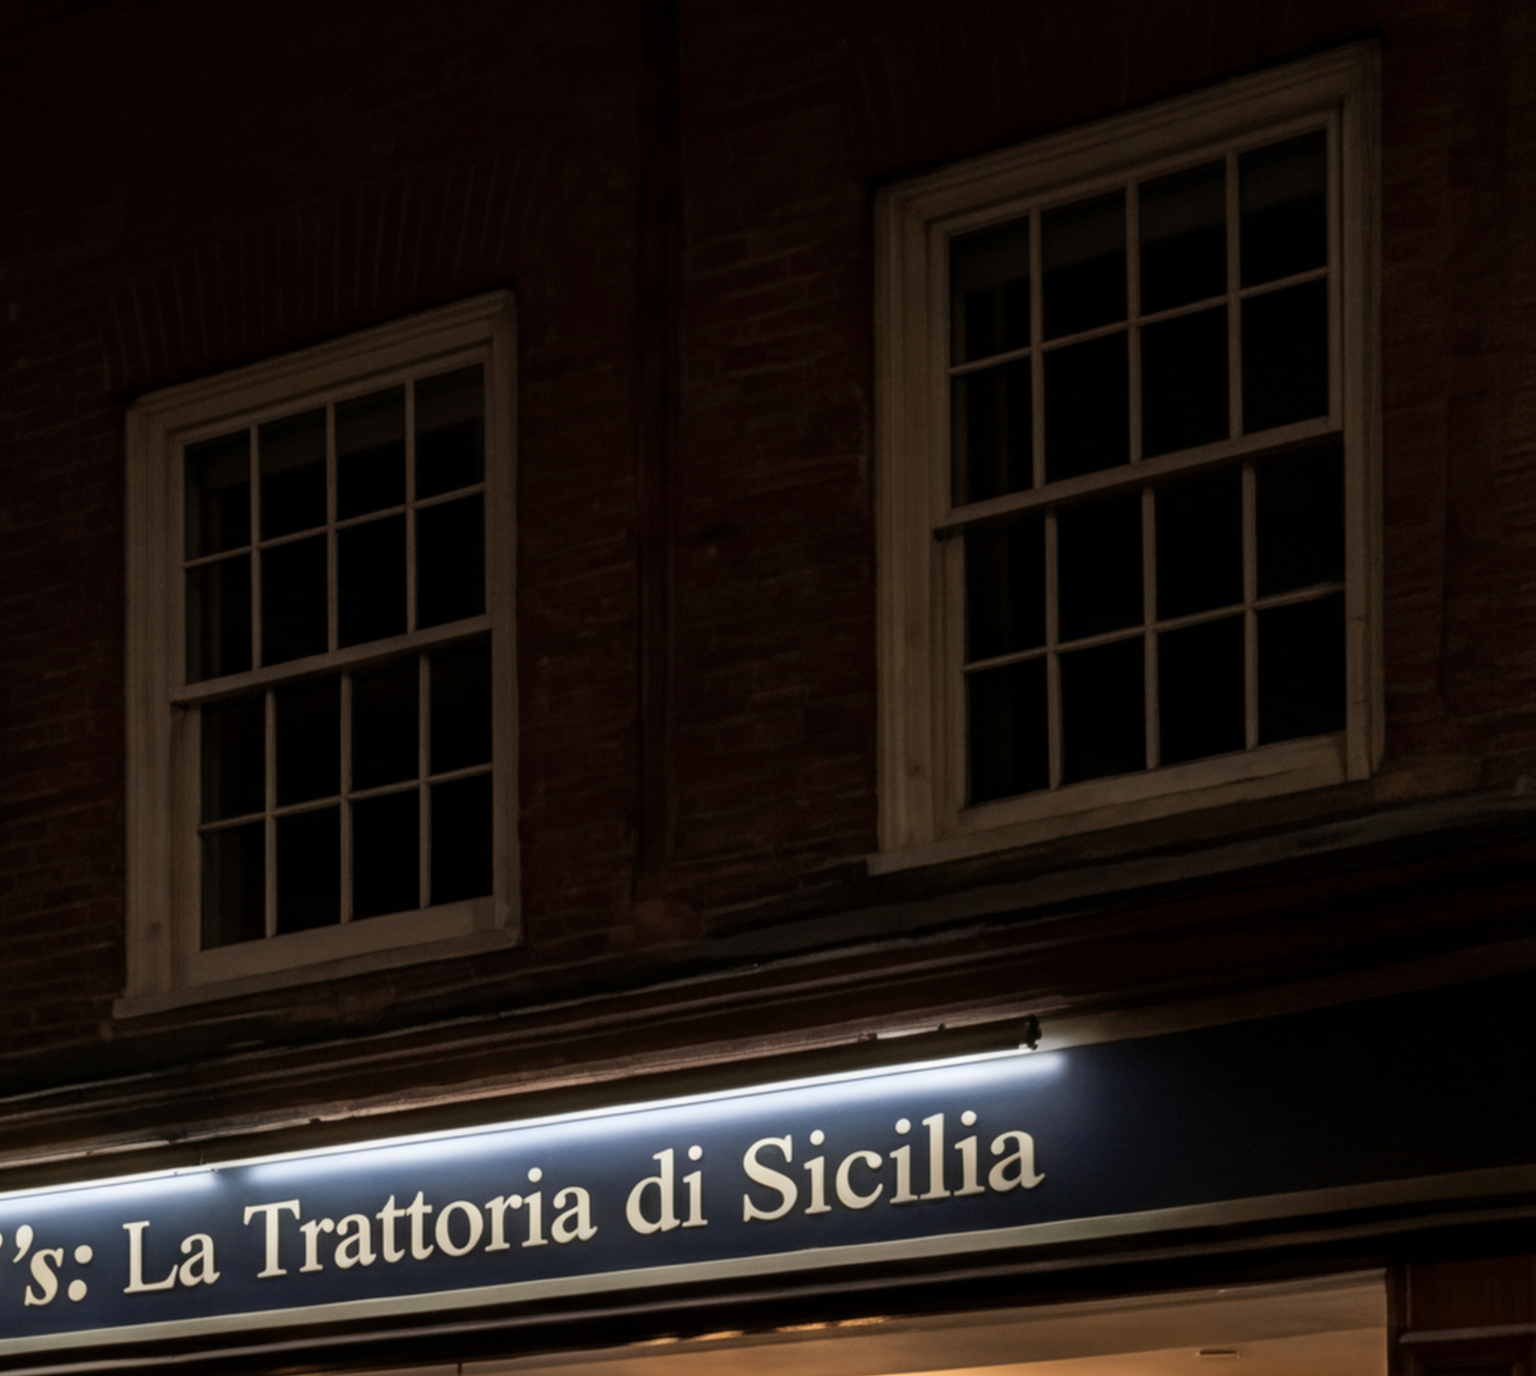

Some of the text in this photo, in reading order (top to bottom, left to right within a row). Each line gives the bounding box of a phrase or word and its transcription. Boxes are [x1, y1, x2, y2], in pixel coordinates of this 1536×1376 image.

[121, 1220, 220, 1295] La
[243, 1167, 598, 1280] Trattoria
[625, 1144, 709, 1236] di
[742, 1109, 1046, 1223] Sicilia
